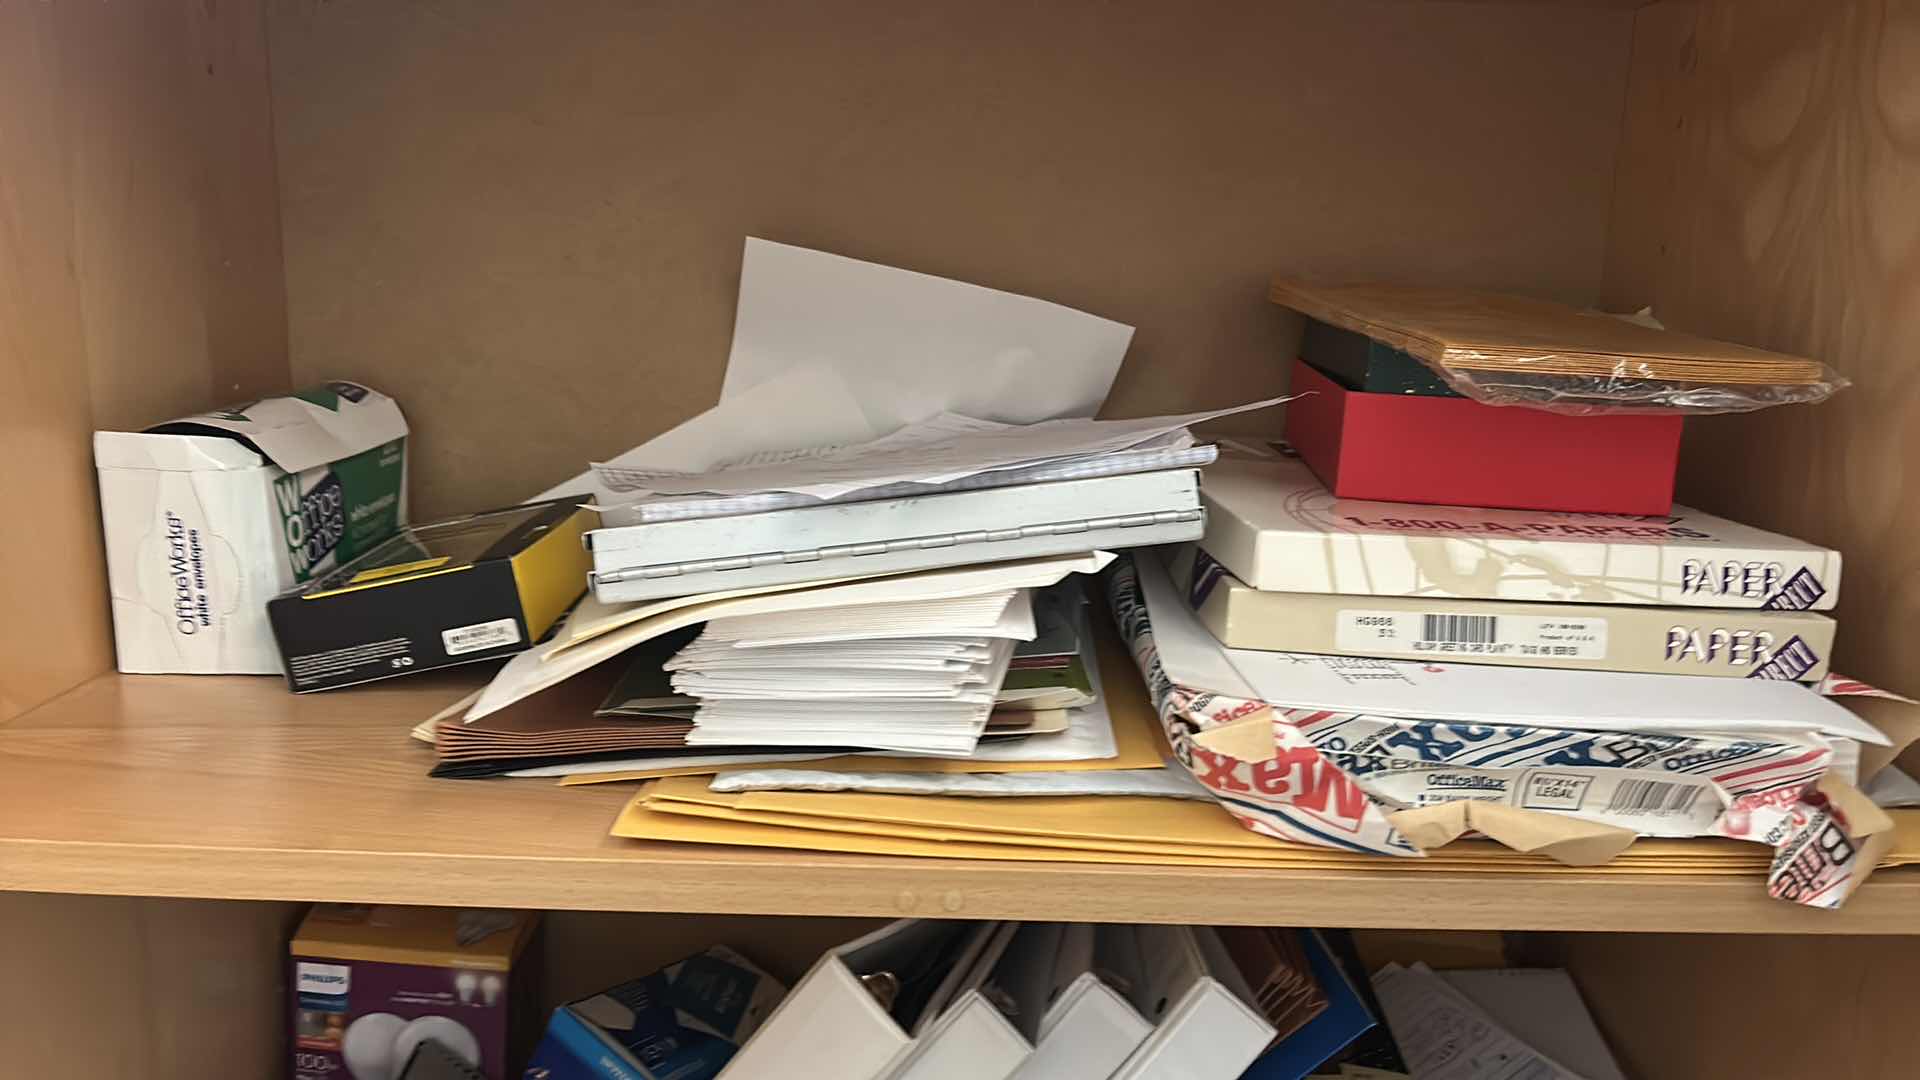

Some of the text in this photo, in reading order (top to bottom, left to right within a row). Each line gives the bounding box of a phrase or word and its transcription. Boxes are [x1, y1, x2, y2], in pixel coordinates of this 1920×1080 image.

[187, 529, 210, 627] white envelopes
[1681, 558, 1785, 600] PAPER
[1665, 625, 1773, 667] PAPER
[1192, 746, 1366, 822] Max
[1426, 773, 1506, 787] OfficeMax
[1534, 786, 1577, 800] LEGAL
